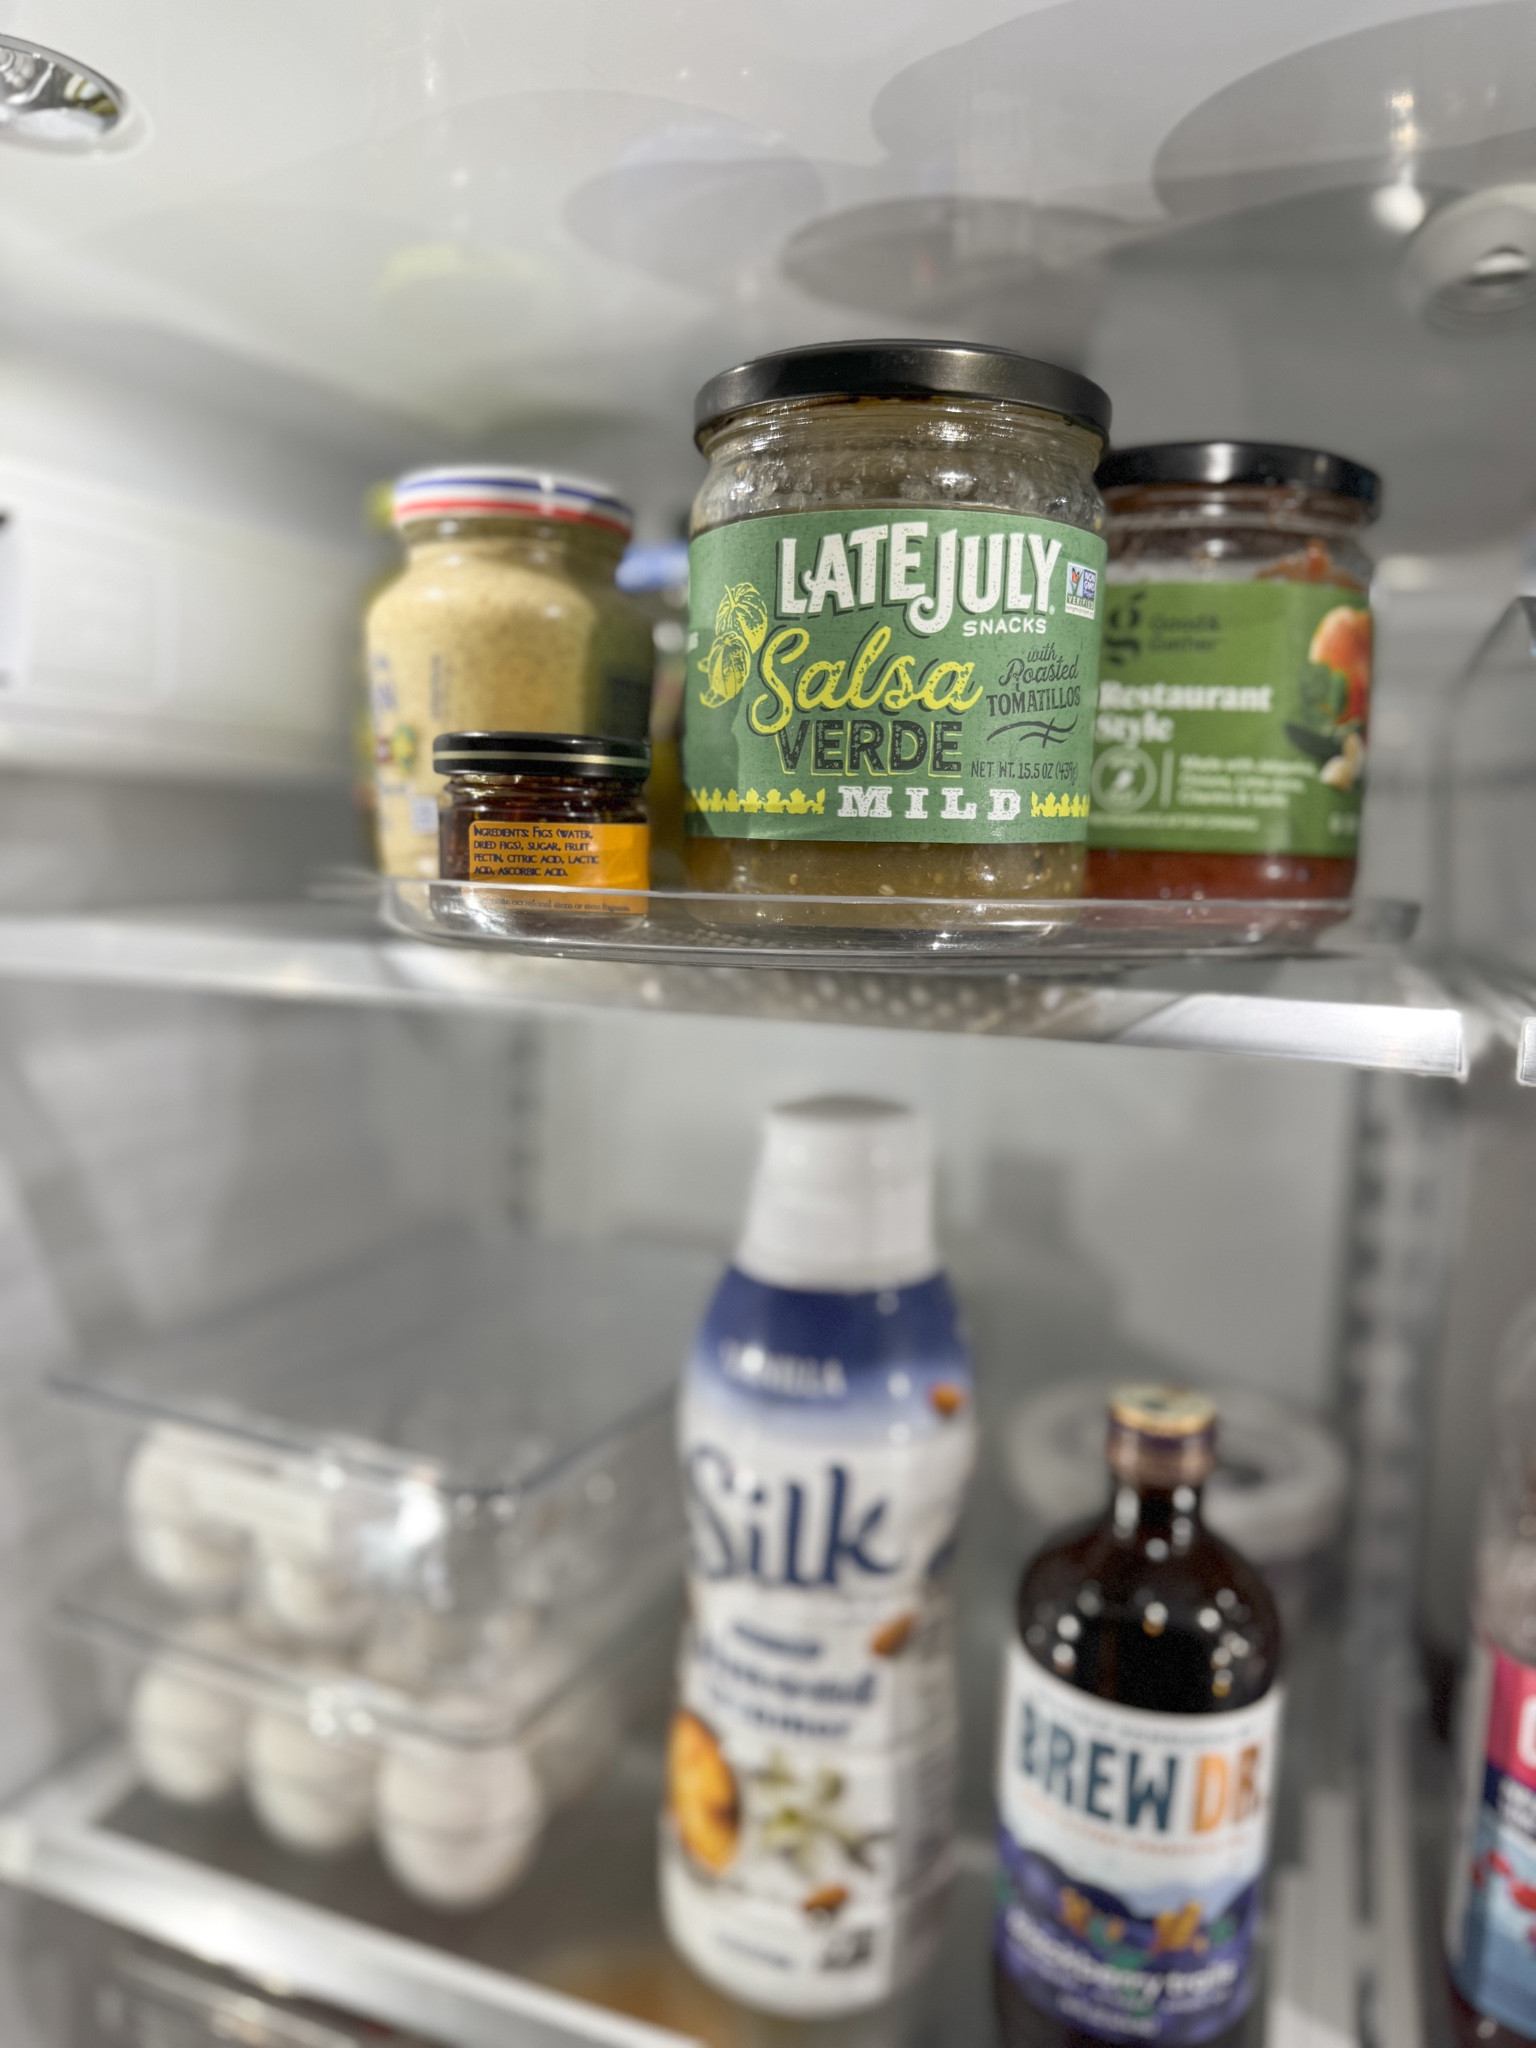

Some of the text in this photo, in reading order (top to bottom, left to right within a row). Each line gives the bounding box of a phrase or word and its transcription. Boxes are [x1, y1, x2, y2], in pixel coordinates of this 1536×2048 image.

[778, 521, 1063, 634] LATE JULY
[962, 616, 1047, 637] SNACKS
[1027, 642, 1058, 663] with
[752, 626, 984, 734] Salsa
[998, 654, 1080, 692] Roasted
[986, 686, 1081, 717] TOMATILLOS
[1098, 681, 1274, 714] Restaurant
[776, 718, 963, 778] VERDE
[970, 760, 995, 778] NET
[999, 761, 1016, 778] WT.
[1018, 762, 1040, 780] 15.5
[1042, 762, 1054, 779] OZ
[836, 785, 1021, 821] MILD
[474, 840, 497, 849] DRIED
[527, 842, 561, 852] SUGAR,
[565, 842, 590, 851] FRUIT
[507, 855, 537, 864] CITRIC
[568, 855, 600, 864] LACTIC
[498, 866, 541, 876] ASCORBIC
[686, 1445, 904, 1588] Silk
[1020, 1701, 1179, 1831] BREW
